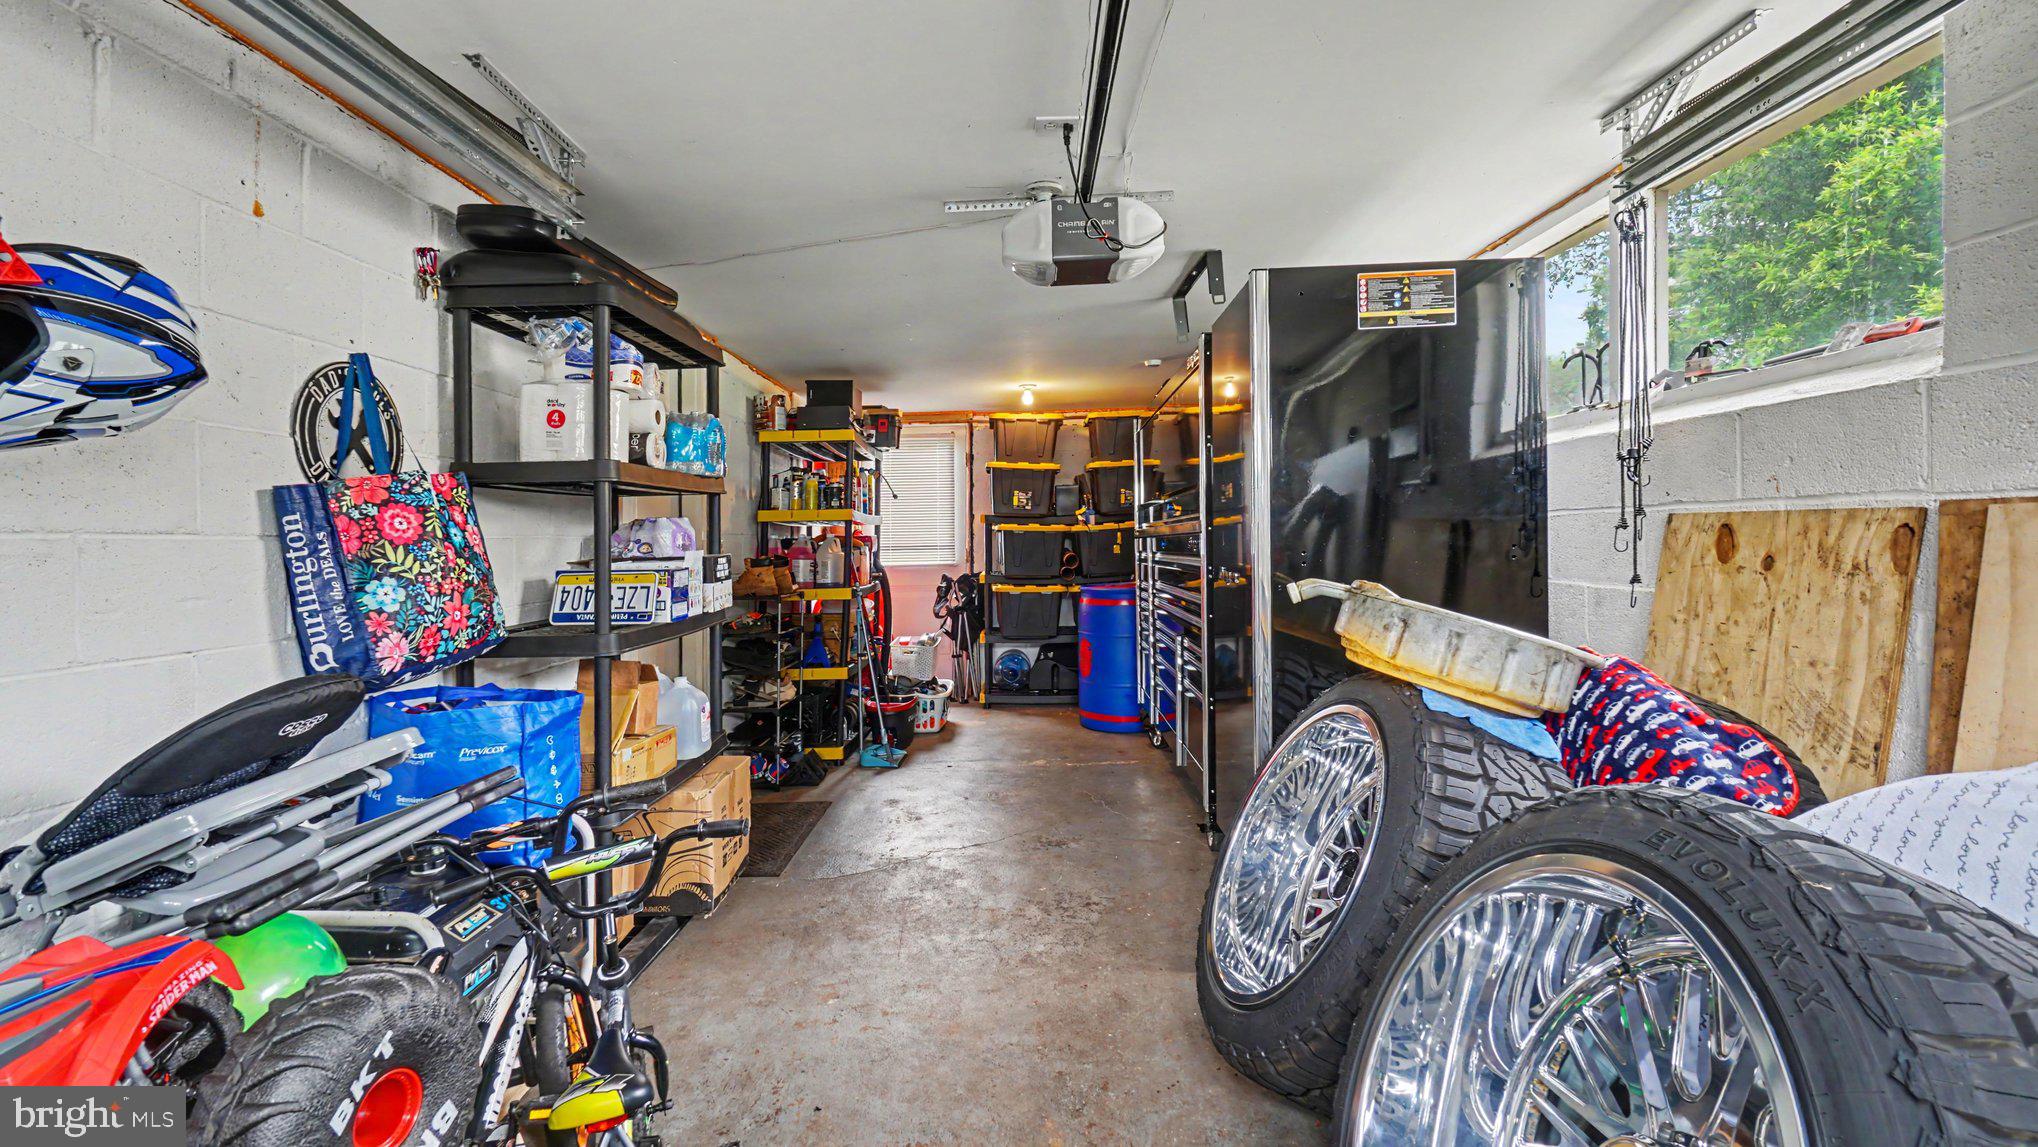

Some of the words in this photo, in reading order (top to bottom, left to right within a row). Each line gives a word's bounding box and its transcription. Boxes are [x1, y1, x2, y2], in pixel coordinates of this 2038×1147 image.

[1057, 219, 1116, 228] CHAMBAIN
[551, 412, 560, 422] 4
[316, 531, 338, 580] DEALS
[281, 512, 340, 672] Burlington
[329, 580, 345, 600] the
[558, 585, 651, 612] LZE-404
[333, 603, 355, 643] LOVE
[459, 745, 509, 758] Previcox
[396, 794, 429, 804] Semint
[1948, 779, 1980, 812] love
[1929, 814, 1950, 852] you
[1998, 810, 2029, 851] love
[1957, 832, 1979, 877] love
[1986, 855, 2001, 901] you
[1638, 826, 1837, 1013] EVOLUXX
[148, 960, 218, 1023] SPIDER-MAN
[329, 1030, 394, 1136] BKT
